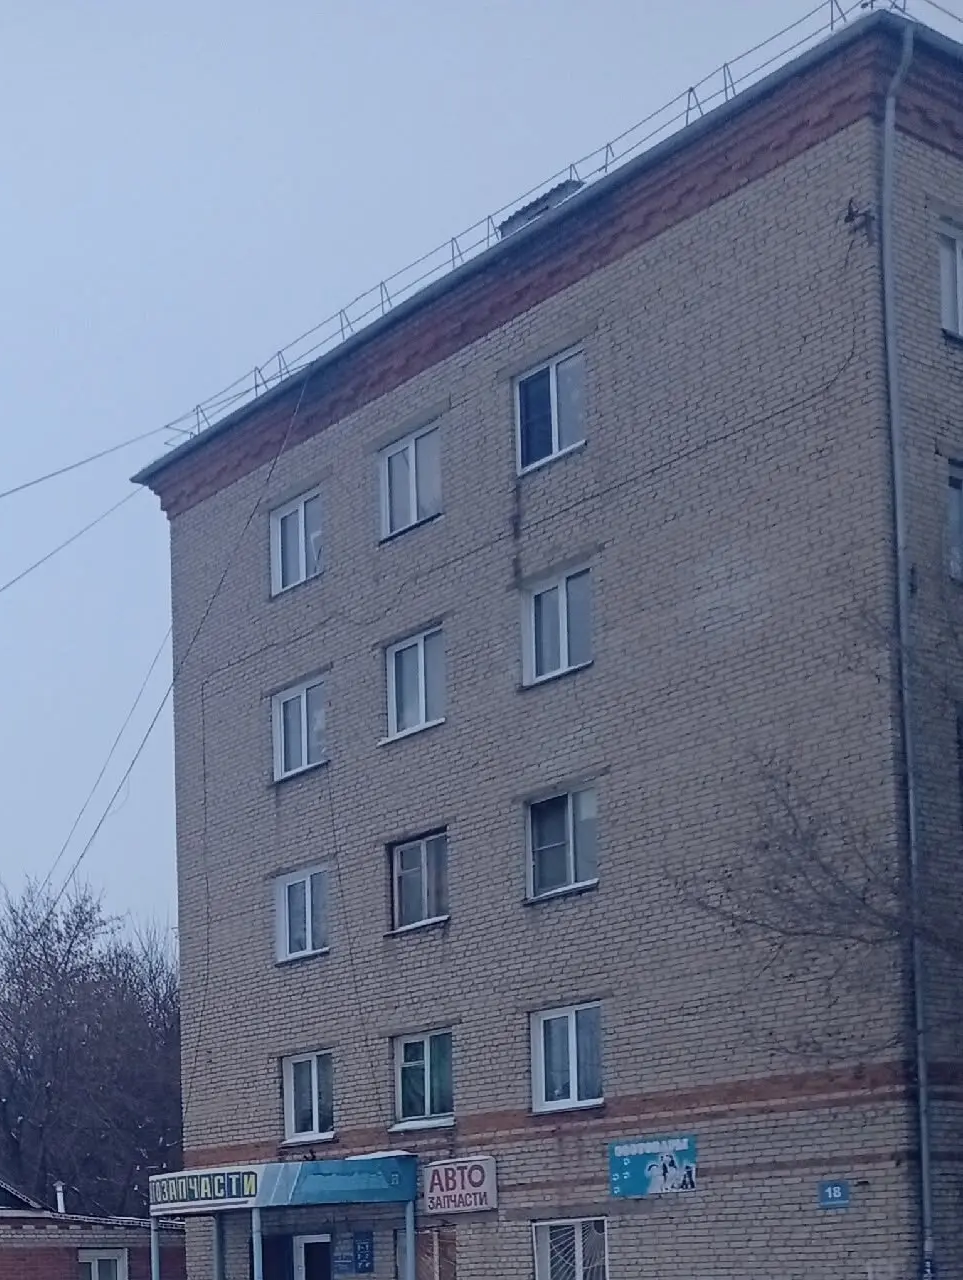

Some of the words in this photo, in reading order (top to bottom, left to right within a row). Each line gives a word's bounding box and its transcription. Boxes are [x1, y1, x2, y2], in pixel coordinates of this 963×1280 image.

[429, 1165, 485, 1193] АВТО
[428, 1192, 489, 1211] ЗАПЧАСТИ
[824, 1186, 842, 1199] 18
